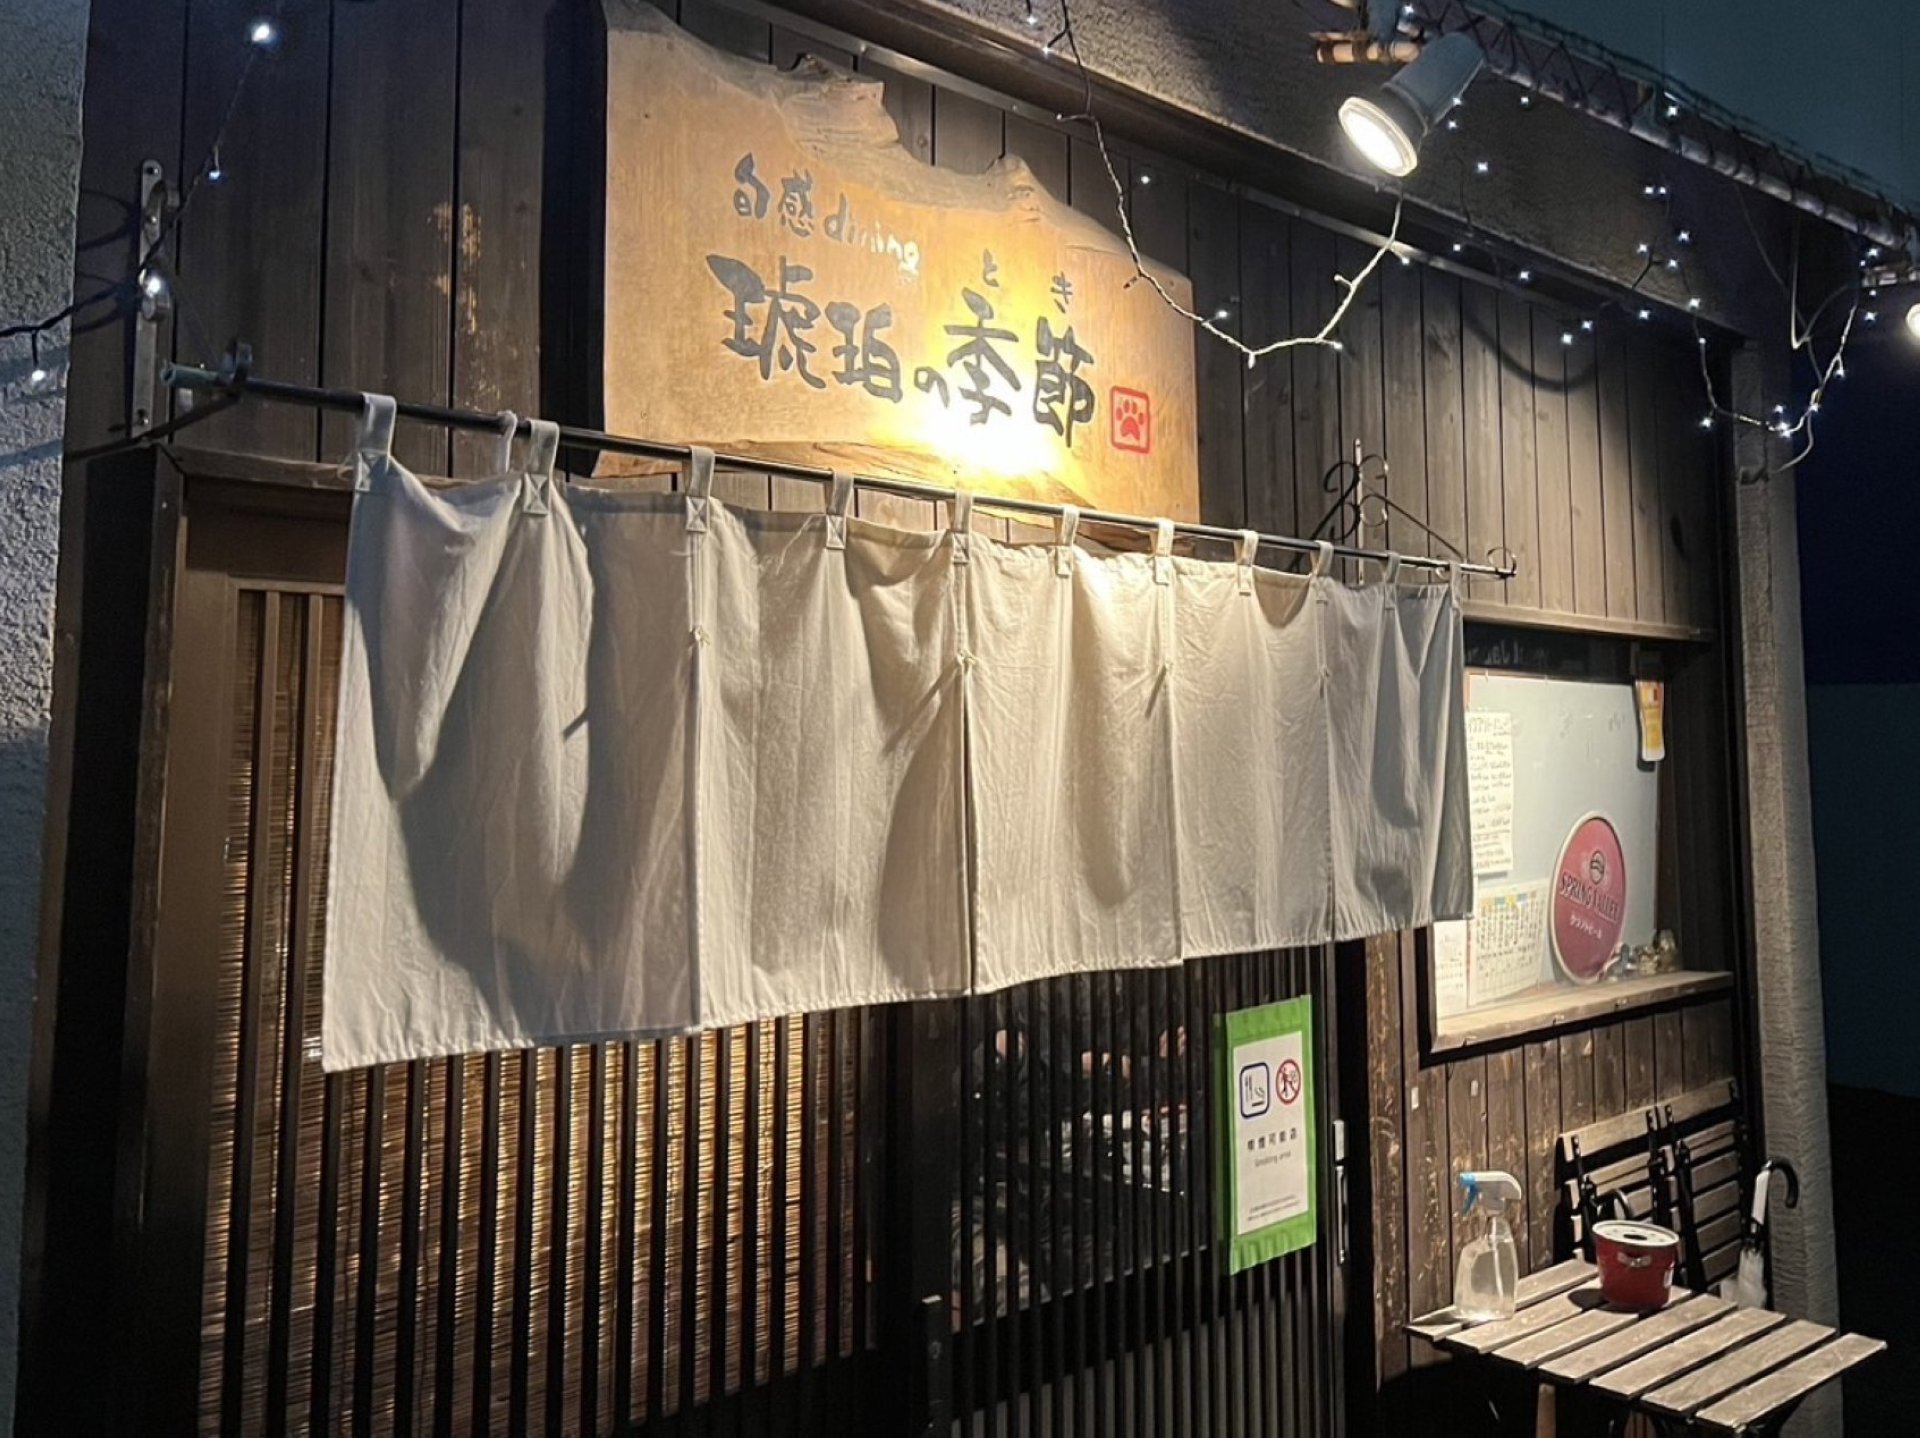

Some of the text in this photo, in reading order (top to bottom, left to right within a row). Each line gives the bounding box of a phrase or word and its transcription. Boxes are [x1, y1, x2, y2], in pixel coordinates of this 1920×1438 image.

[706, 254, 1095, 448] 琥珀の季節
